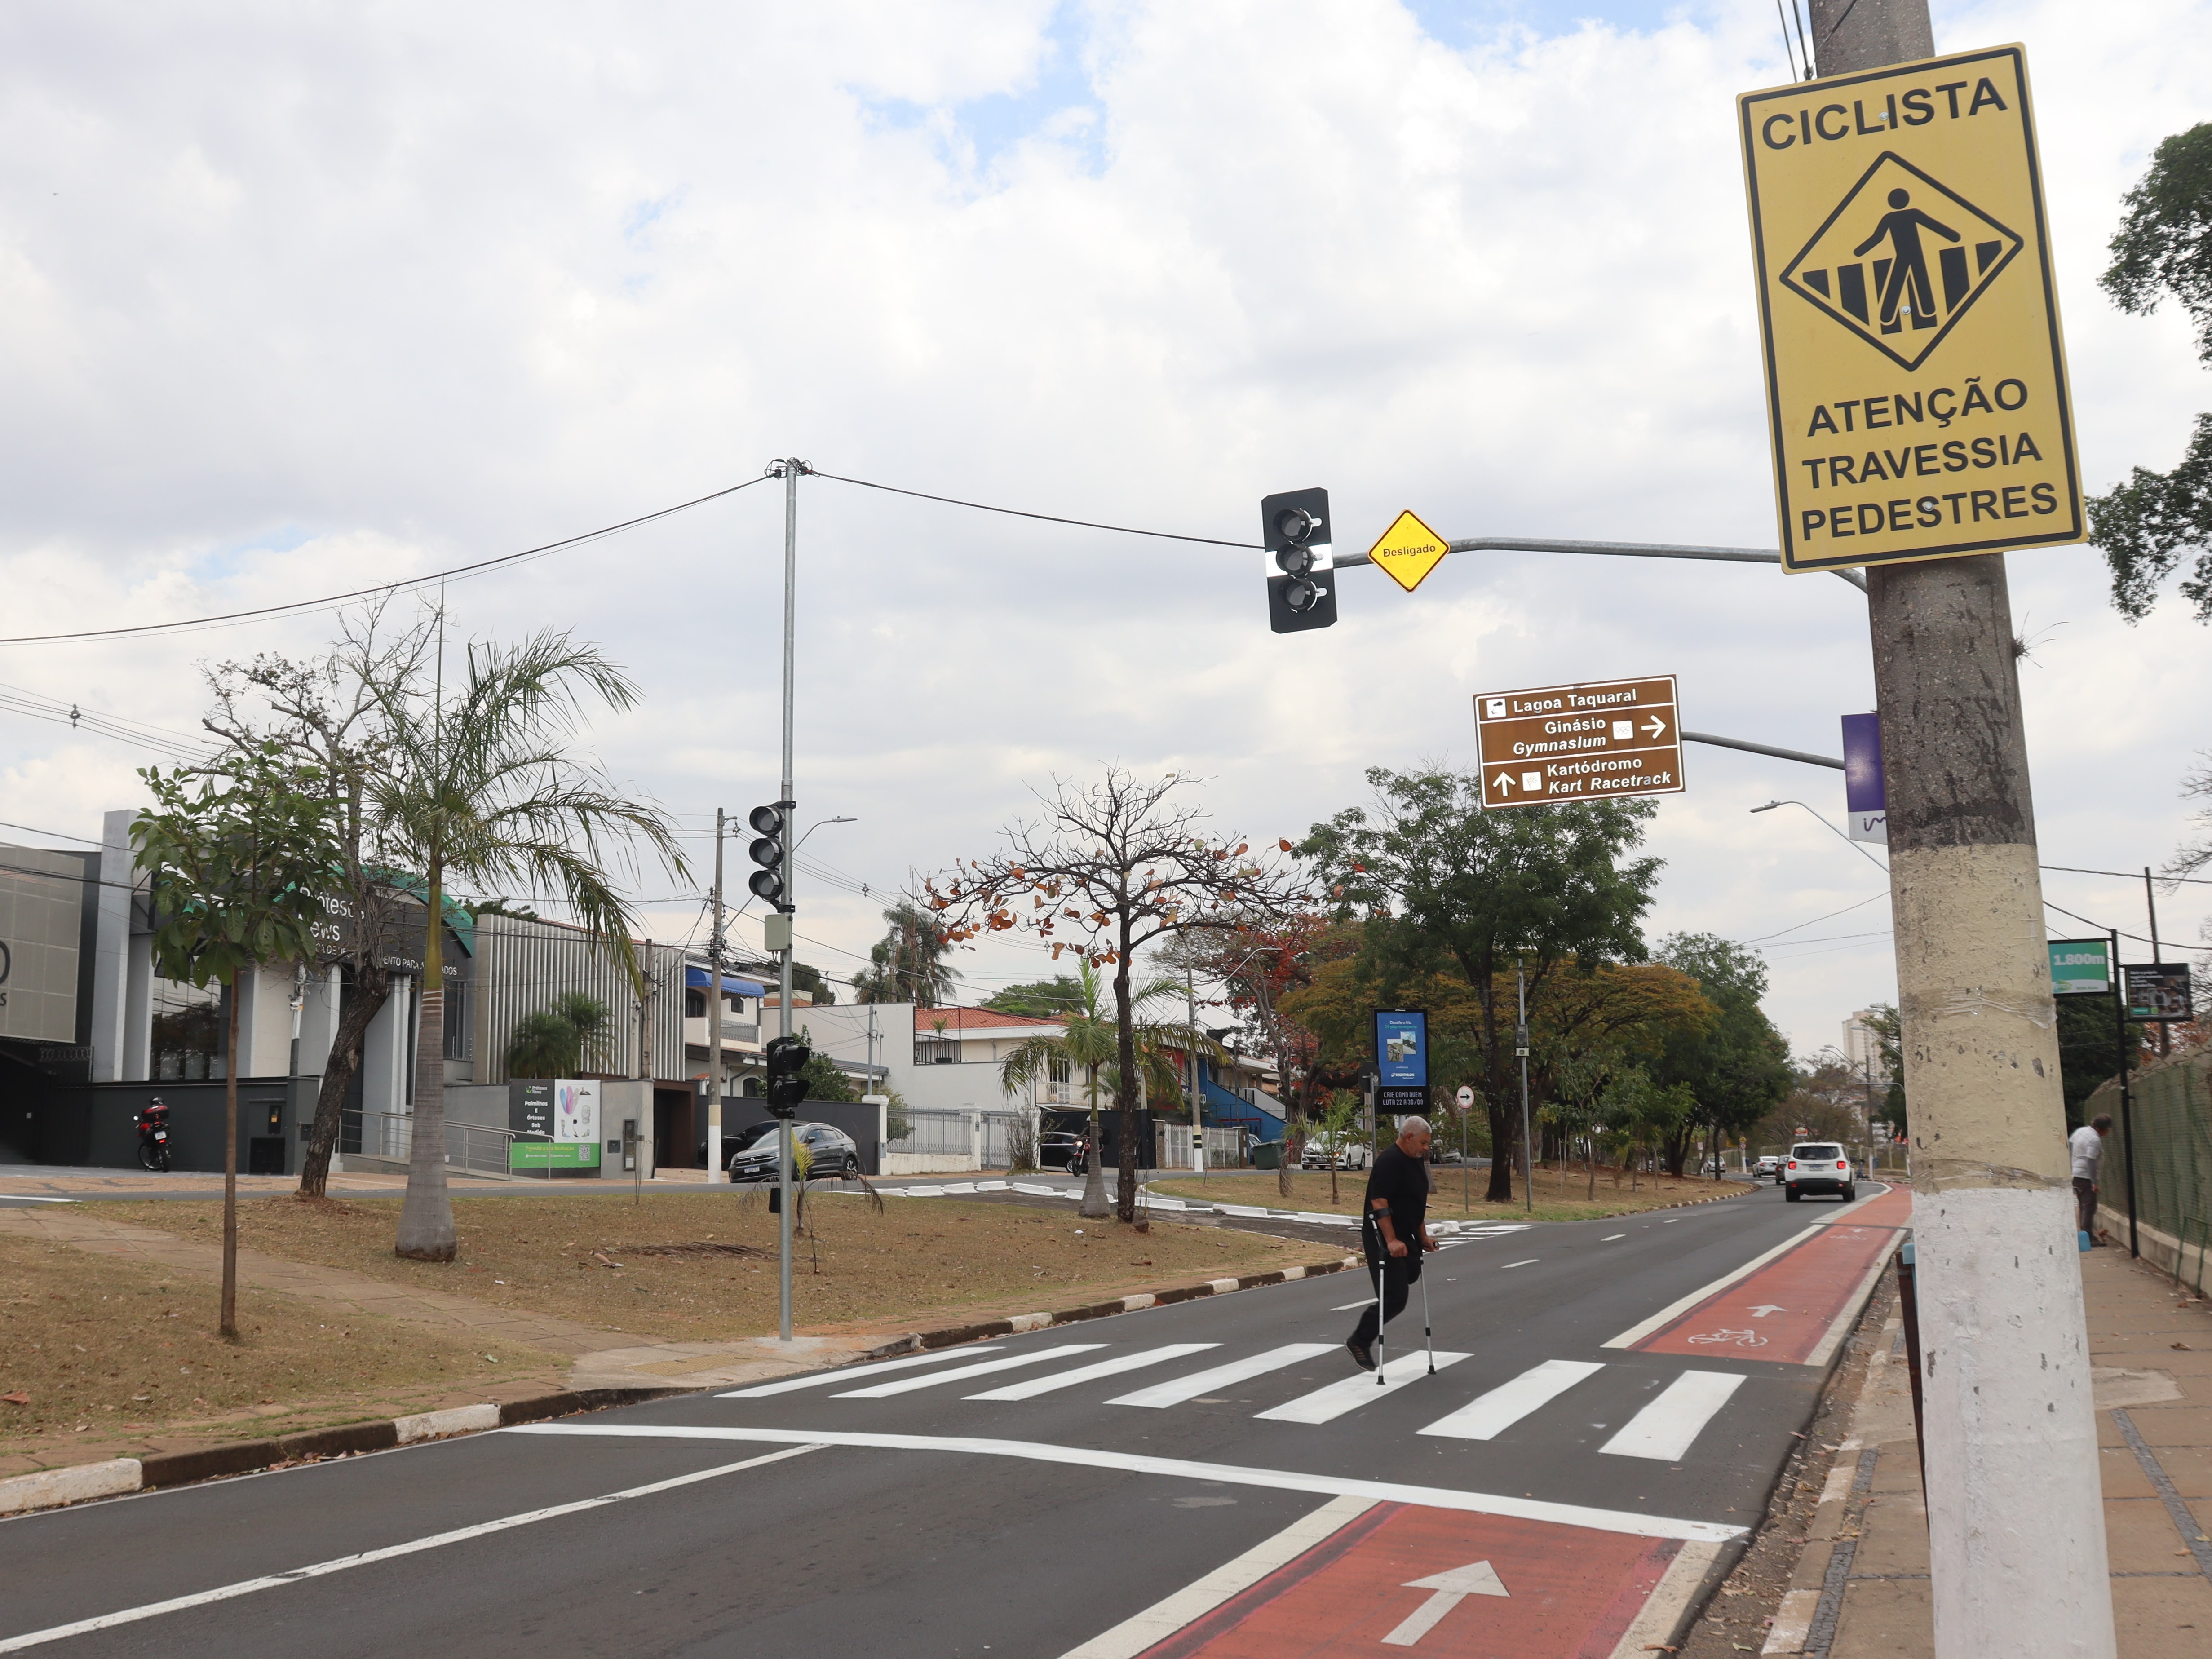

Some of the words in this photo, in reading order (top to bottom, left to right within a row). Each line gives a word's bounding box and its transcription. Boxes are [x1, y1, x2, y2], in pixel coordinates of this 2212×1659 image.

[1762, 77, 2008, 150] CICLISTA
[1807, 376, 2028, 437] ATENÇÃO
[1802, 432, 2043, 489] TRAVESSIA
[1801, 482, 2058, 541] PEDESTRES
[1383, 544, 1436, 557] Desligado
[1513, 699, 1562, 714] Lagoa
[1567, 688, 1637, 708] Taquaral
[1545, 717, 1606, 734] Ginásio
[1513, 736, 1606, 757] Gymnasium
[1547, 758, 1643, 778] Kartódromo
[1548, 779, 1582, 795] Kart
[1591, 771, 1671, 791] Racetrack
[2054, 953, 2106, 965] 1.800m
